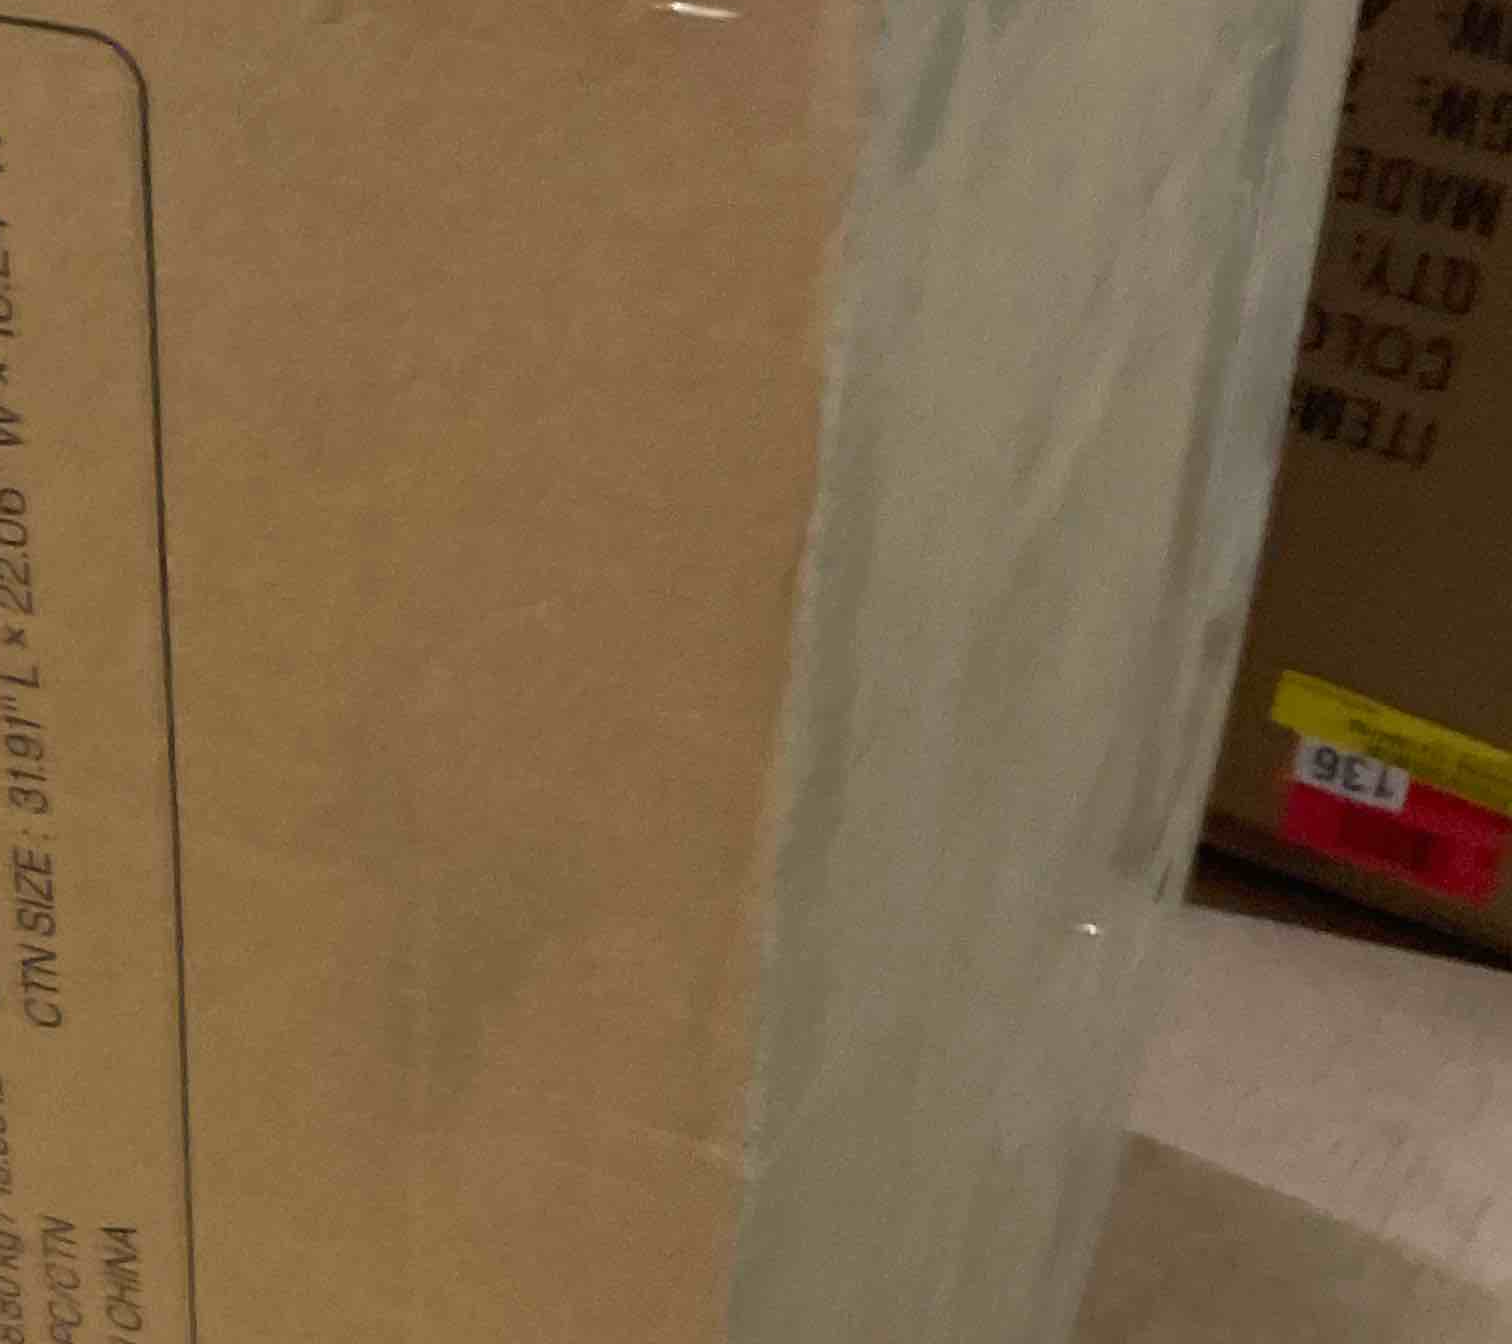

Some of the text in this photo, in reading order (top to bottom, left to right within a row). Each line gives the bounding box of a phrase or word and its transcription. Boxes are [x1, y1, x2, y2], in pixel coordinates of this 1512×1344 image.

[1338, 146, 1503, 236] MADE
[1313, 745, 1395, 799] 136
[20, 944, 64, 1029] CTN
[97, 1224, 143, 1330] CHINA
